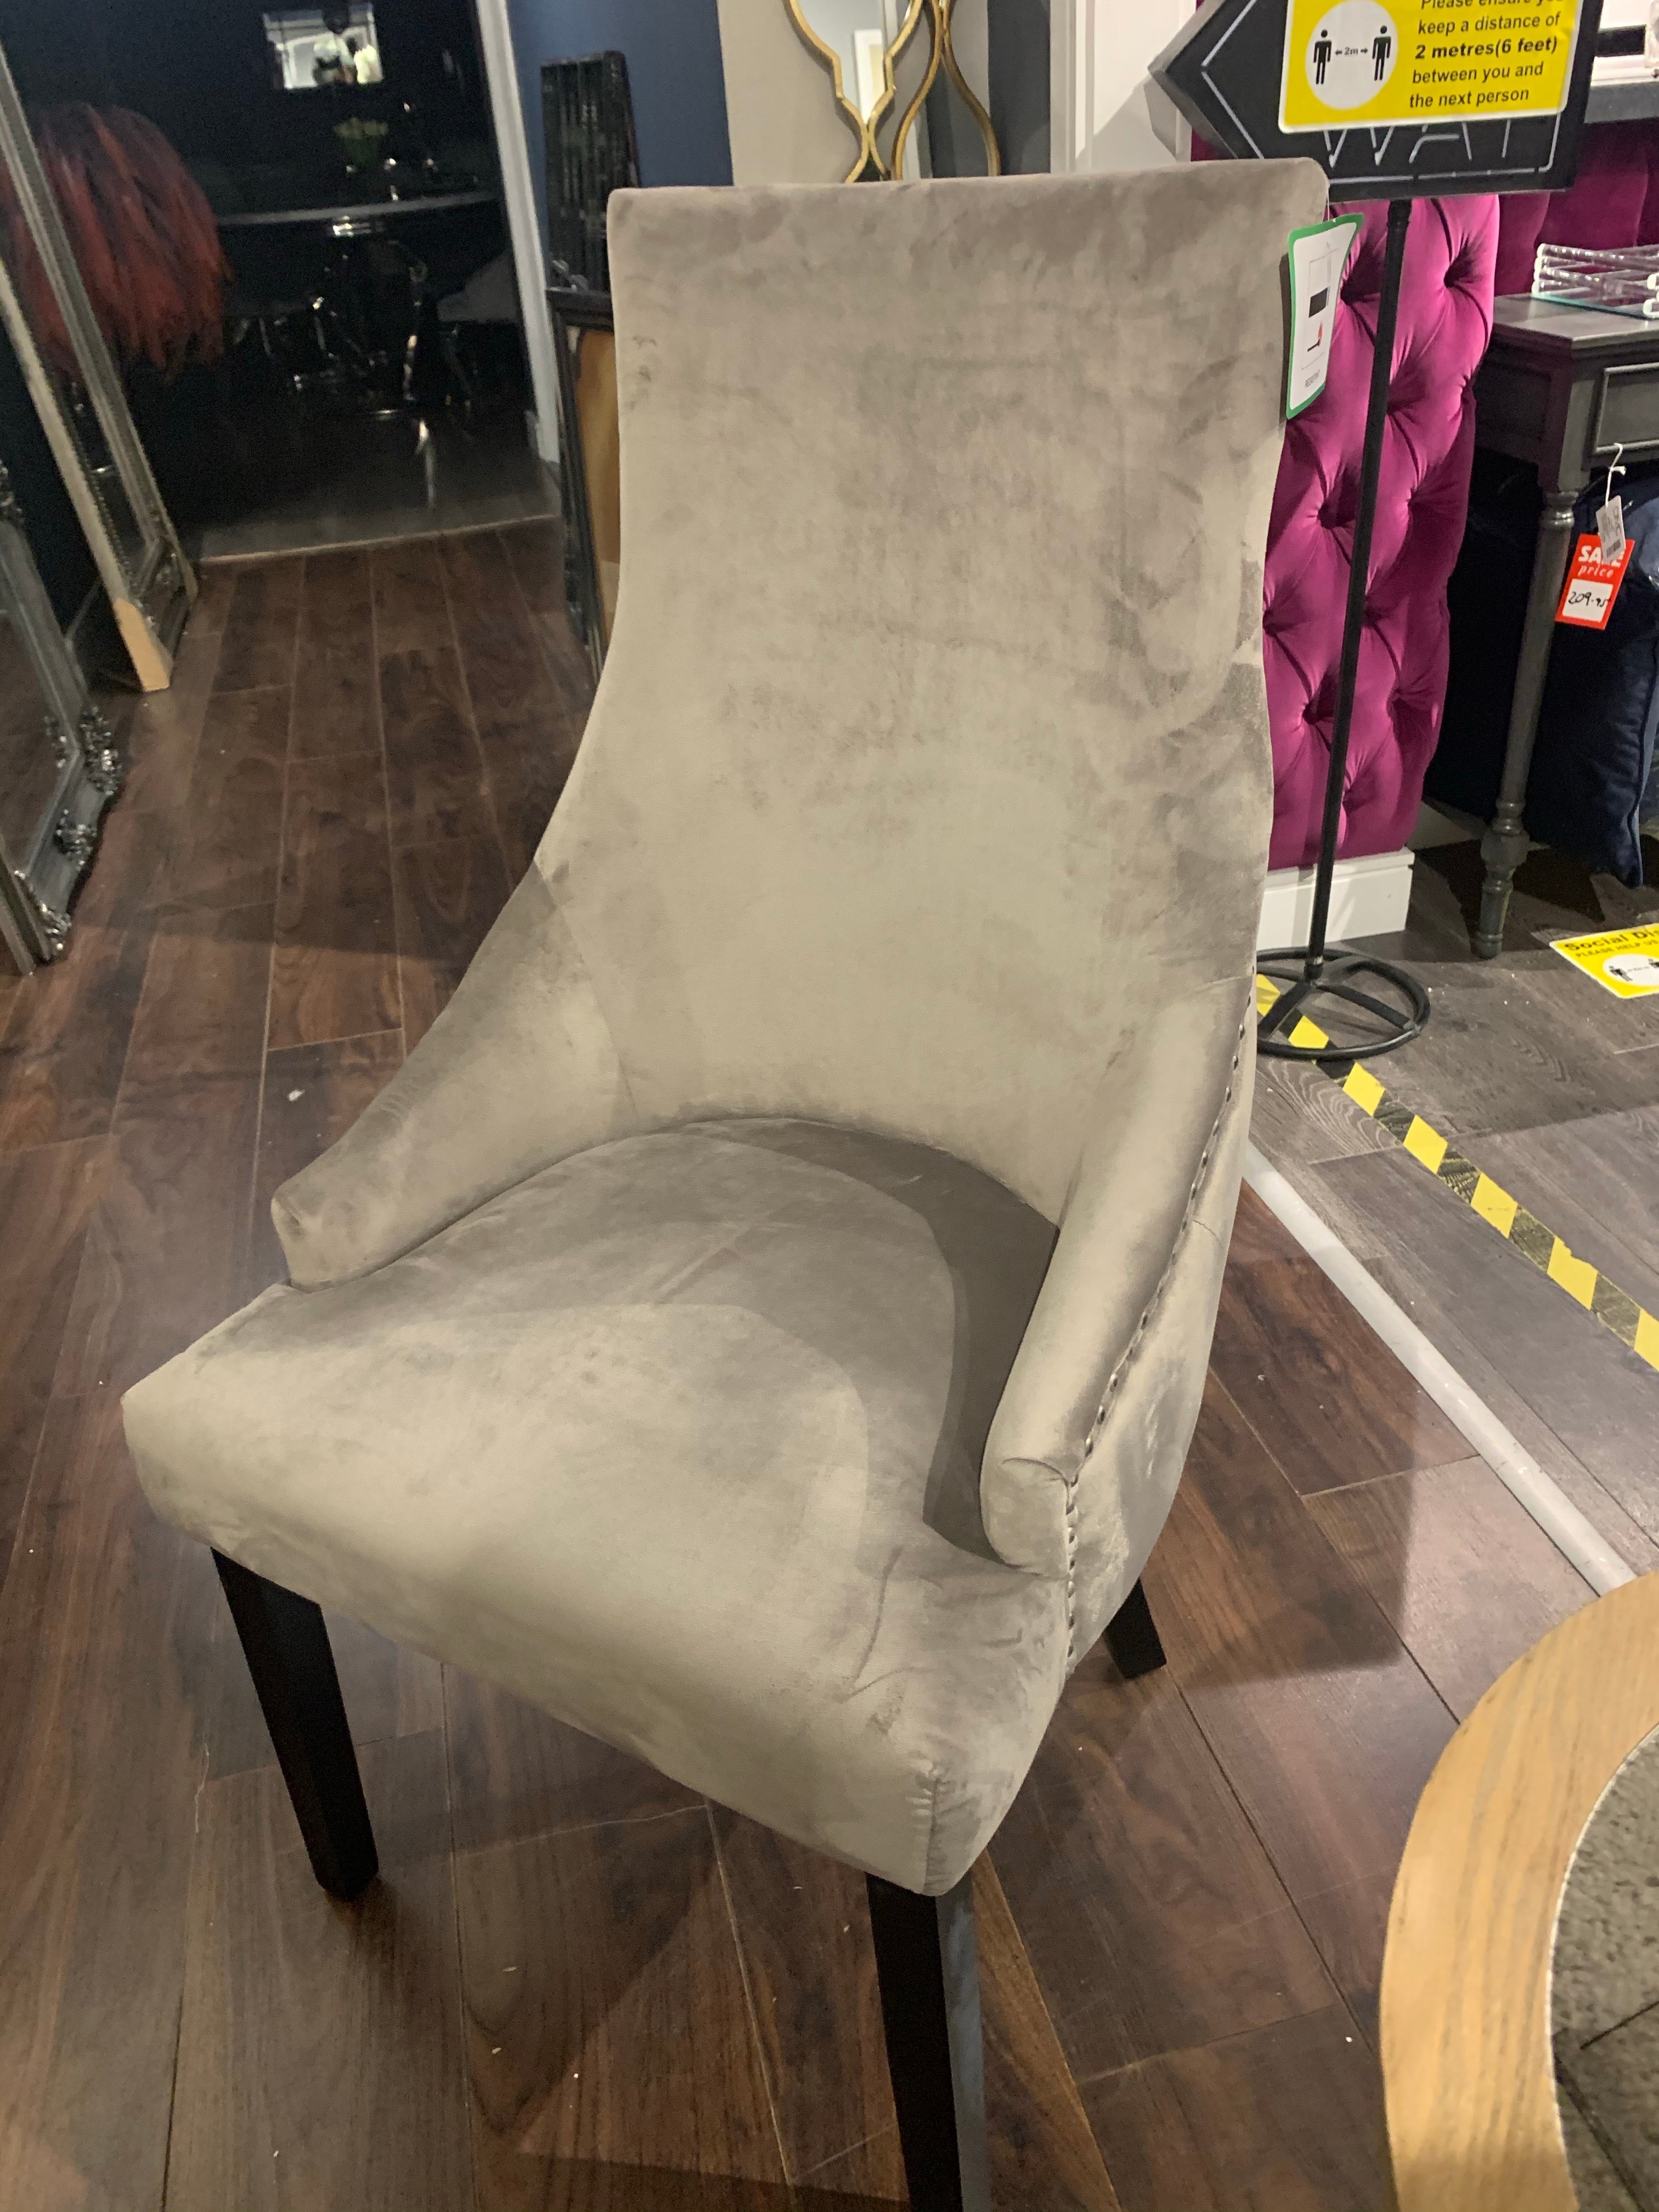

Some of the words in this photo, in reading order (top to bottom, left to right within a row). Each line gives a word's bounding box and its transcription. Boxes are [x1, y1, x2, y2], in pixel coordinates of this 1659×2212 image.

[1418, 19, 1456, 36] keep
[1460, 20, 1469, 32] a
[1475, 15, 1541, 31] distance
[1545, 11, 1561, 26] of
[1344, 46, 1359, 55] 2m
[1415, 44, 1426, 59] 2
[1517, 36, 1558, 54] feet)
[1412, 69, 1477, 84] between
[1482, 66, 1510, 83] you
[1515, 60, 1544, 77] and
[1409, 93, 1434, 108] the
[1438, 90, 1472, 106] next
[1476, 88, 1530, 107] person
[1577, 564, 1614, 579] price
[1565, 934, 1629, 951] Social
